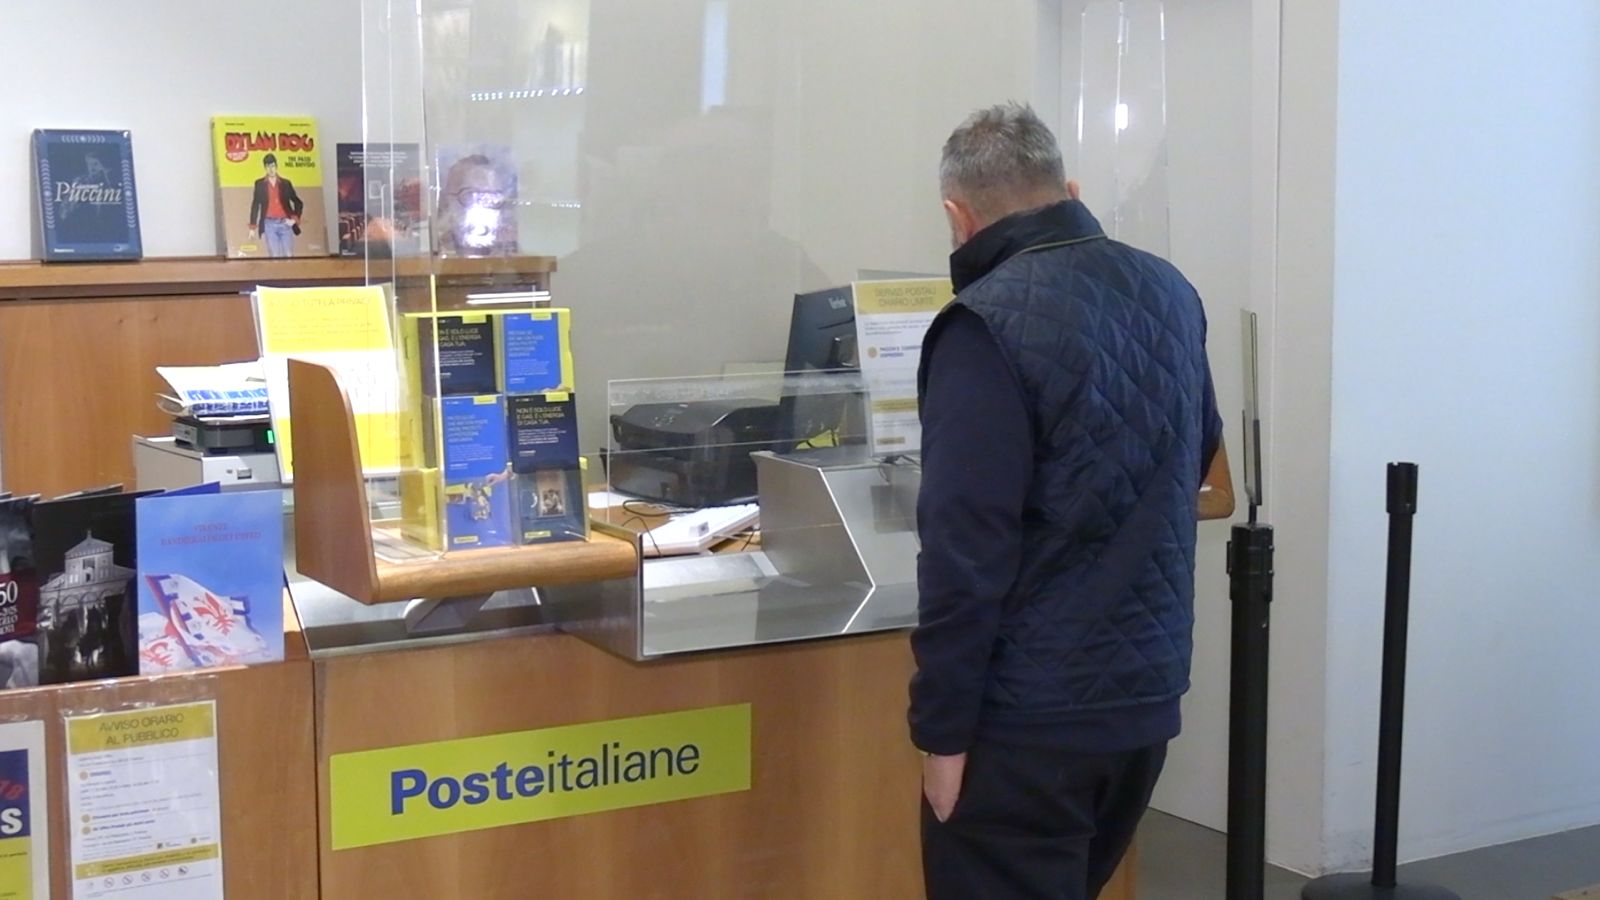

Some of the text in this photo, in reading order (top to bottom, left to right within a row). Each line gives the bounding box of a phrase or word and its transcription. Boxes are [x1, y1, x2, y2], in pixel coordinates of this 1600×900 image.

[224, 130, 314, 152] DYLAN DOG
[54, 181, 122, 202] Puccini
[905, 286, 937, 295] POSTALI
[99, 713, 184, 732] AVVISO ORARIO
[105, 727, 179, 745] AL PUBBLICO
